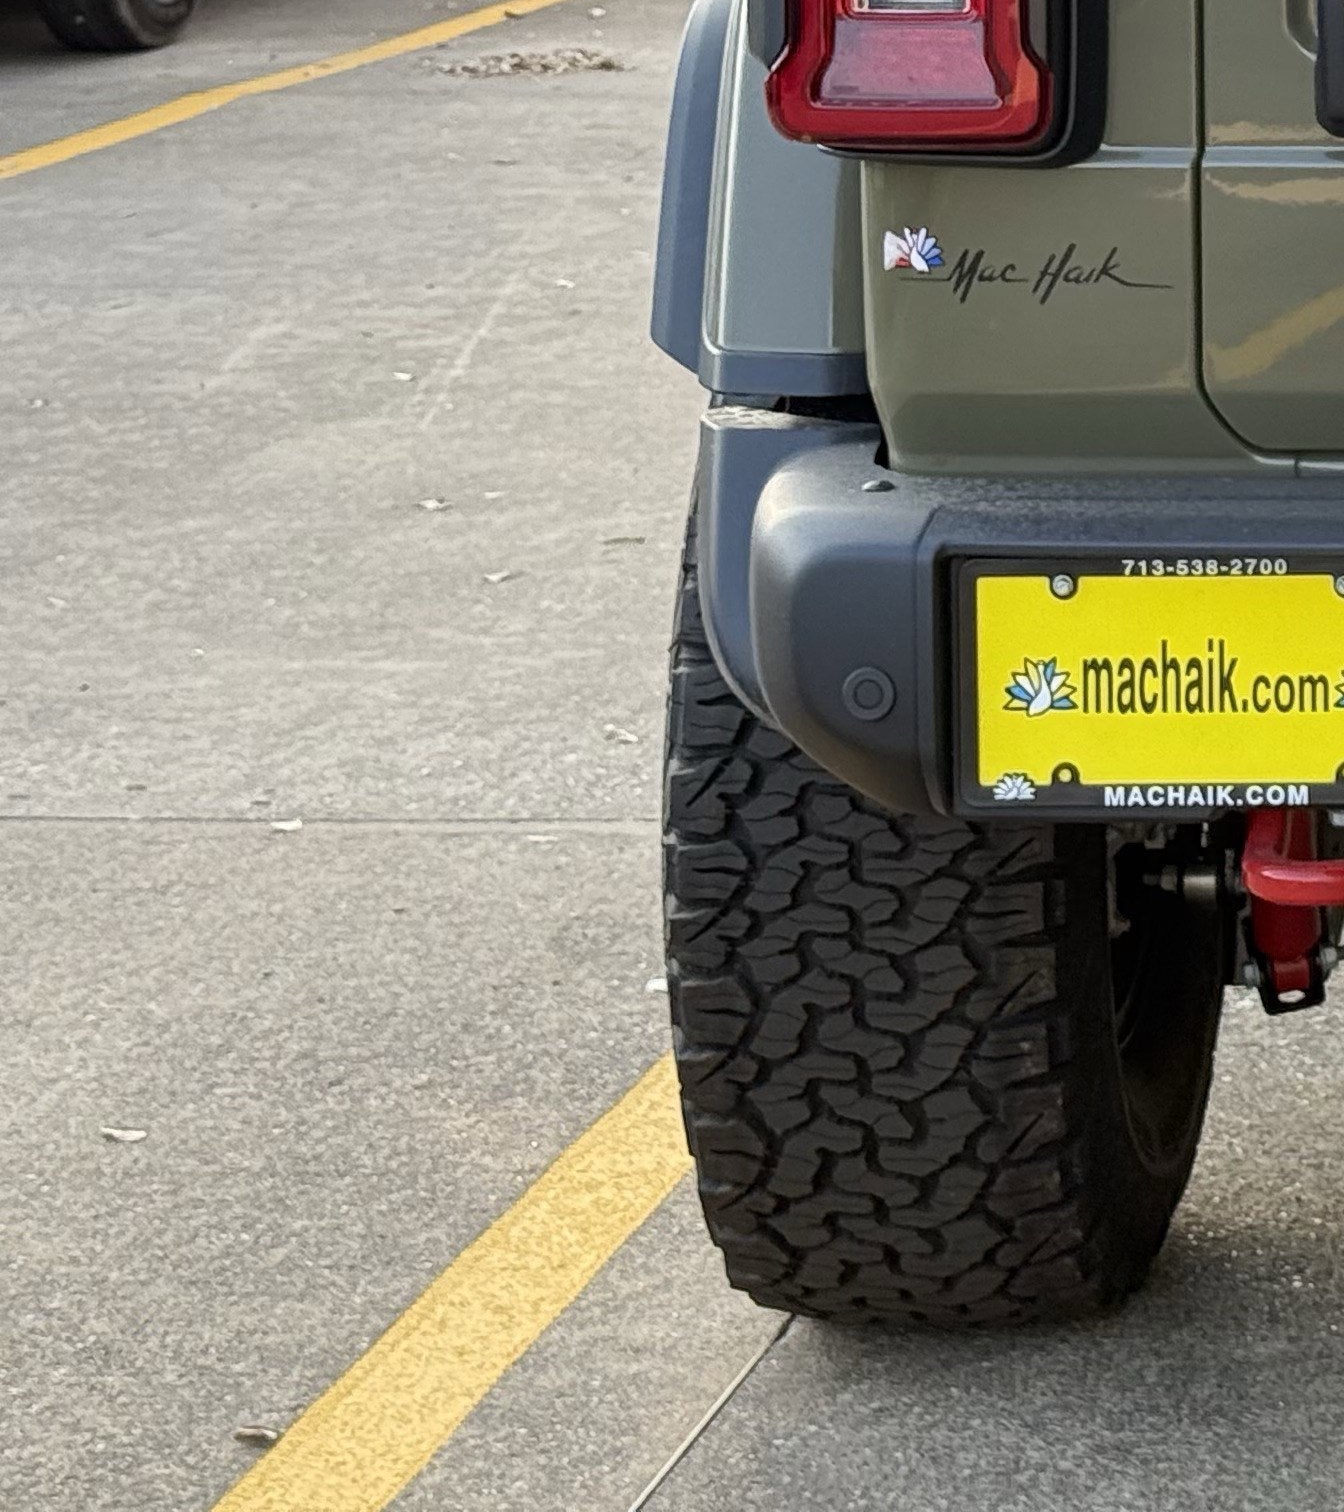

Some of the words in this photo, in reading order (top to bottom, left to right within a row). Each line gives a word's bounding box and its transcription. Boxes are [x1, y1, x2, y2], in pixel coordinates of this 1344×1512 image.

[949, 247, 1028, 305] Mac
[1120, 558, 1289, 576] 713-538-2700
[1081, 639, 1331, 714] machaik.com
[1103, 784, 1310, 807] MACHAIK.COM
